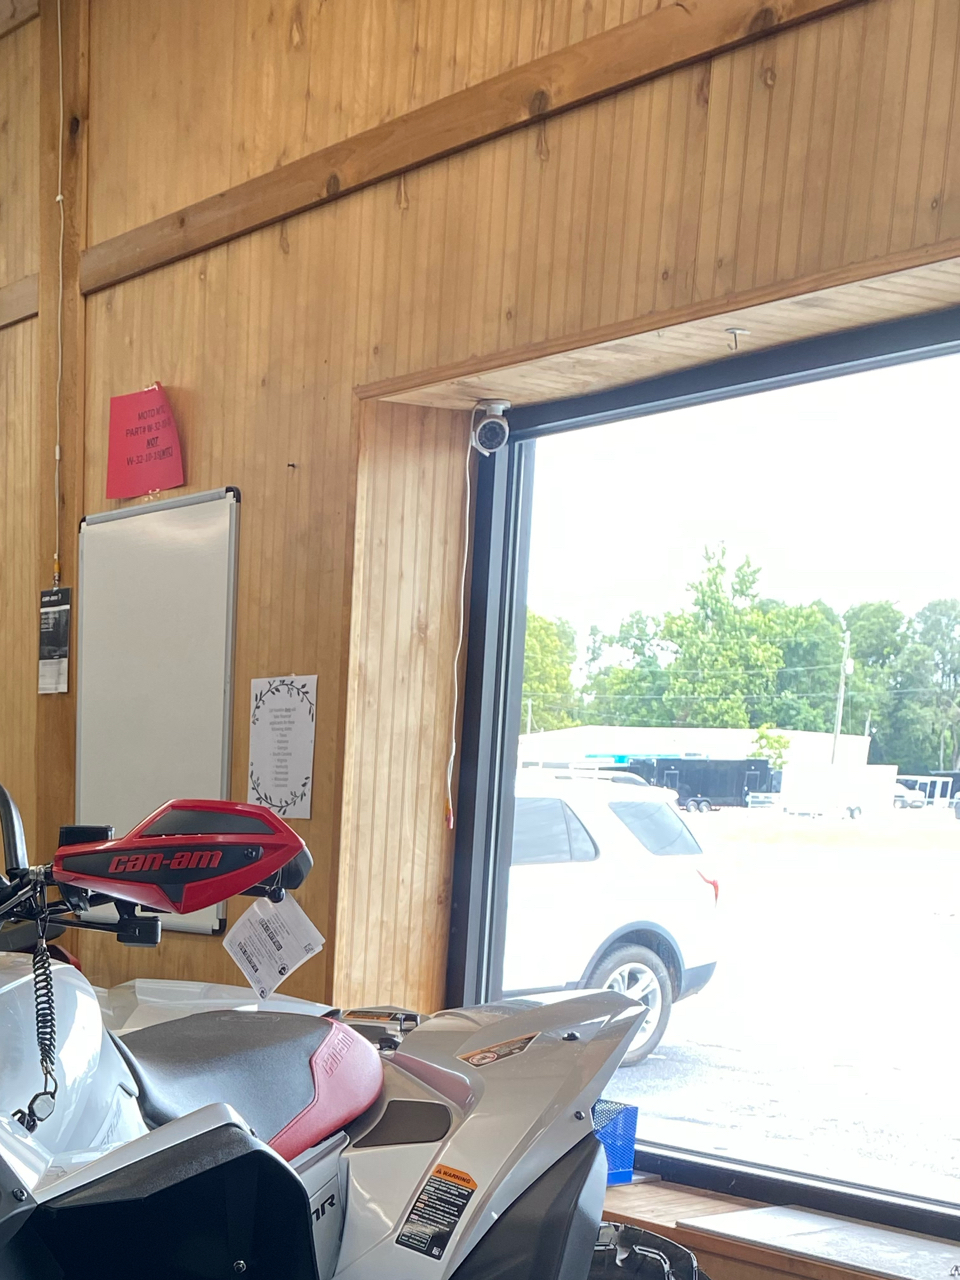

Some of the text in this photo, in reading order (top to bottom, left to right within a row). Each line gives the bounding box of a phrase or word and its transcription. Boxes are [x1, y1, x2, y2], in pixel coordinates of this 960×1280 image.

[125, 426, 146, 437] PART#
[146, 436, 159, 447] NOT
[108, 850, 222, 874] can-am
[322, 1031, 354, 1078] can-am
[442, 1170, 471, 1184] WARNING
